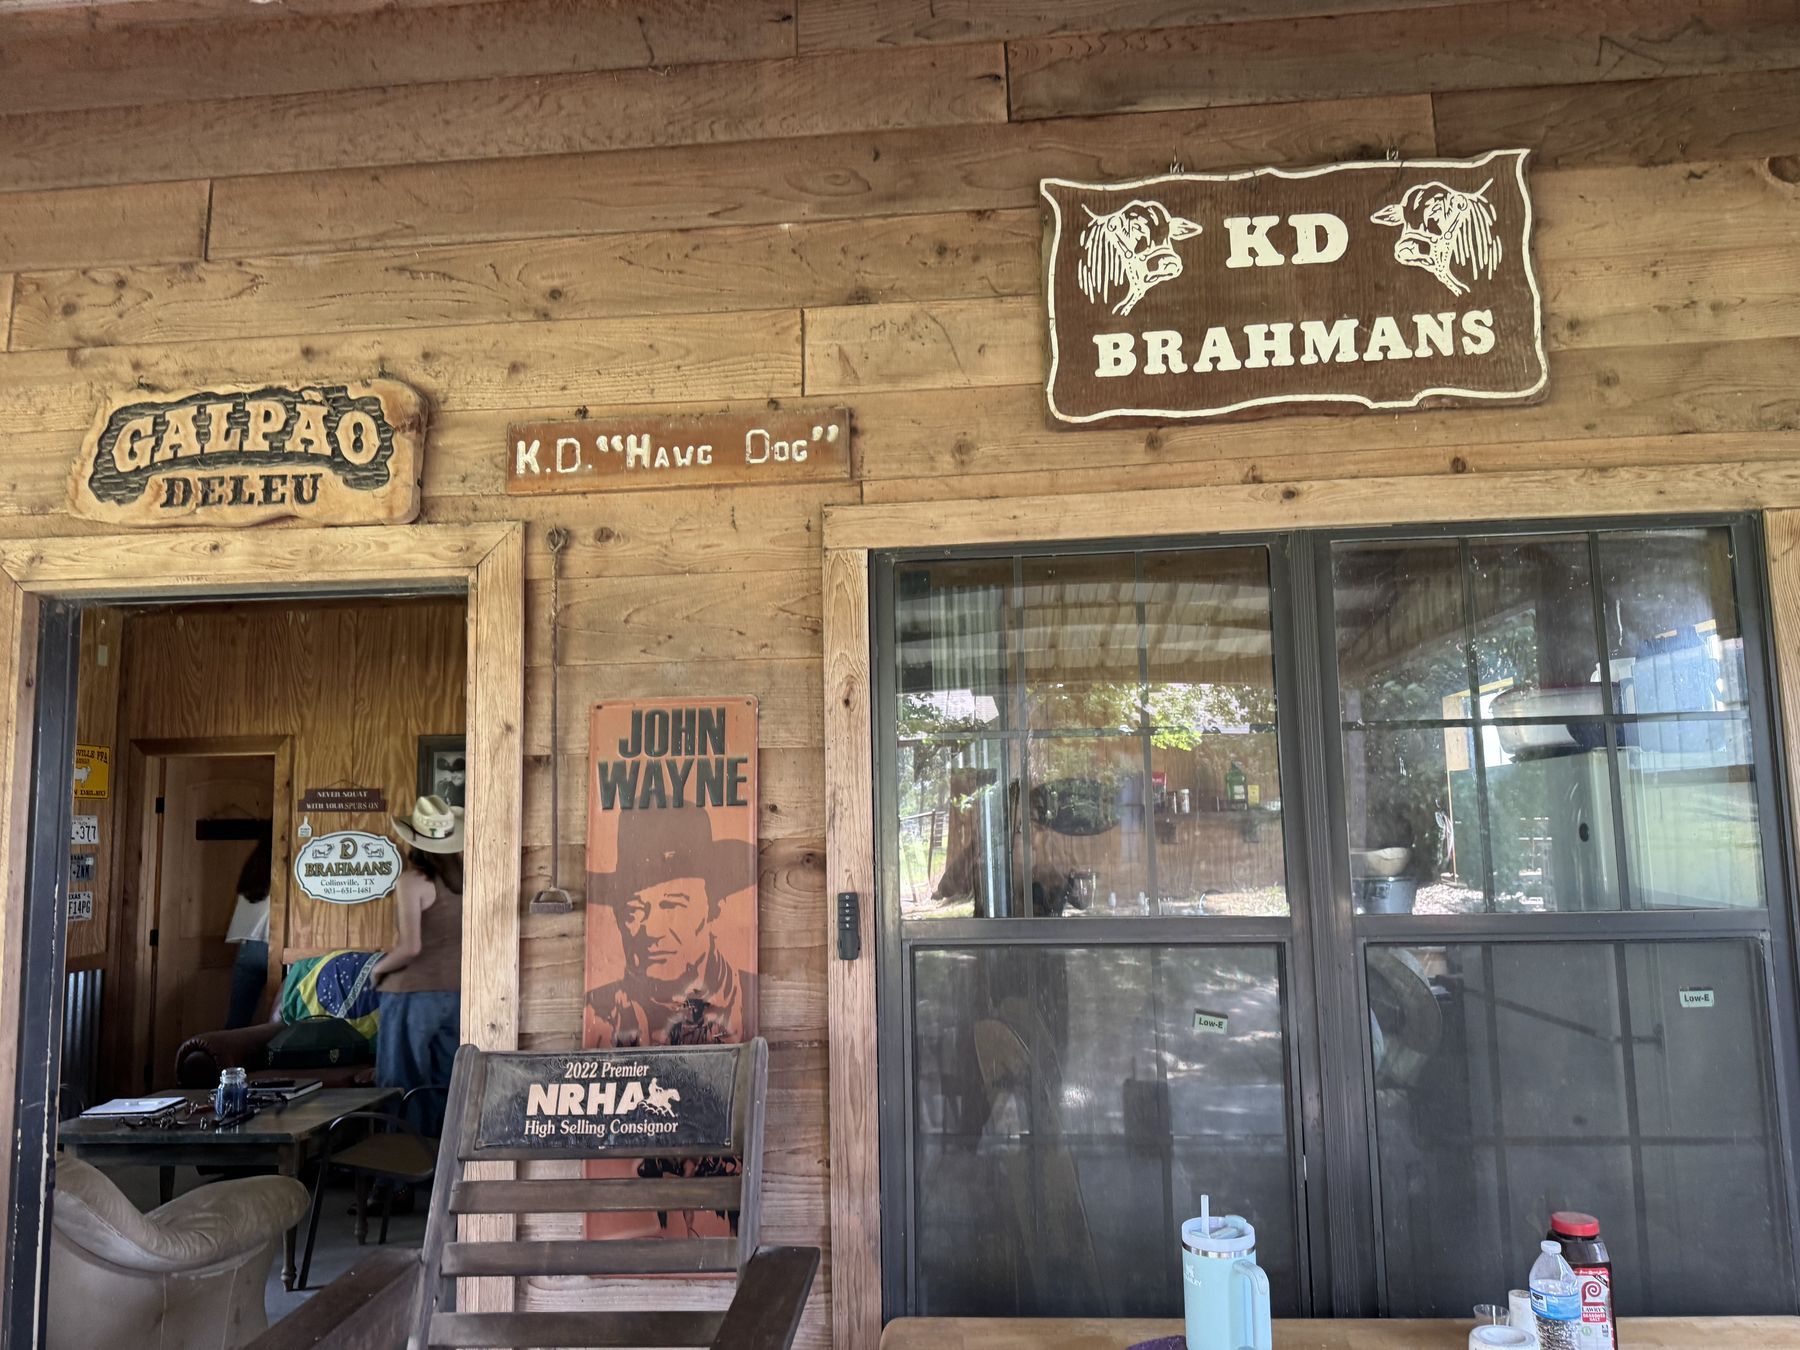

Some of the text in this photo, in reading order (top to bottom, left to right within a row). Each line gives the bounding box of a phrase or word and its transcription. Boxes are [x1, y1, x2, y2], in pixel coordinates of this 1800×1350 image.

[1223, 212, 1349, 269] KD
[1092, 309, 1496, 378] BRAHMANS
[516, 437, 592, 475] K.D.
[160, 473, 323, 508] DELEU
[618, 706, 726, 758] JOHN
[597, 757, 748, 811] WAYNE
[344, 802, 367, 810] SPURS
[368, 801, 379, 809] ON
[304, 861, 393, 877] BRAHMANS
[320, 878, 375, 887] Collinsville, TX
[564, 1061, 649, 1079] 2022 Premier
[526, 1081, 646, 1116] NRHA
[524, 1118, 679, 1138] High Selling Consignor
